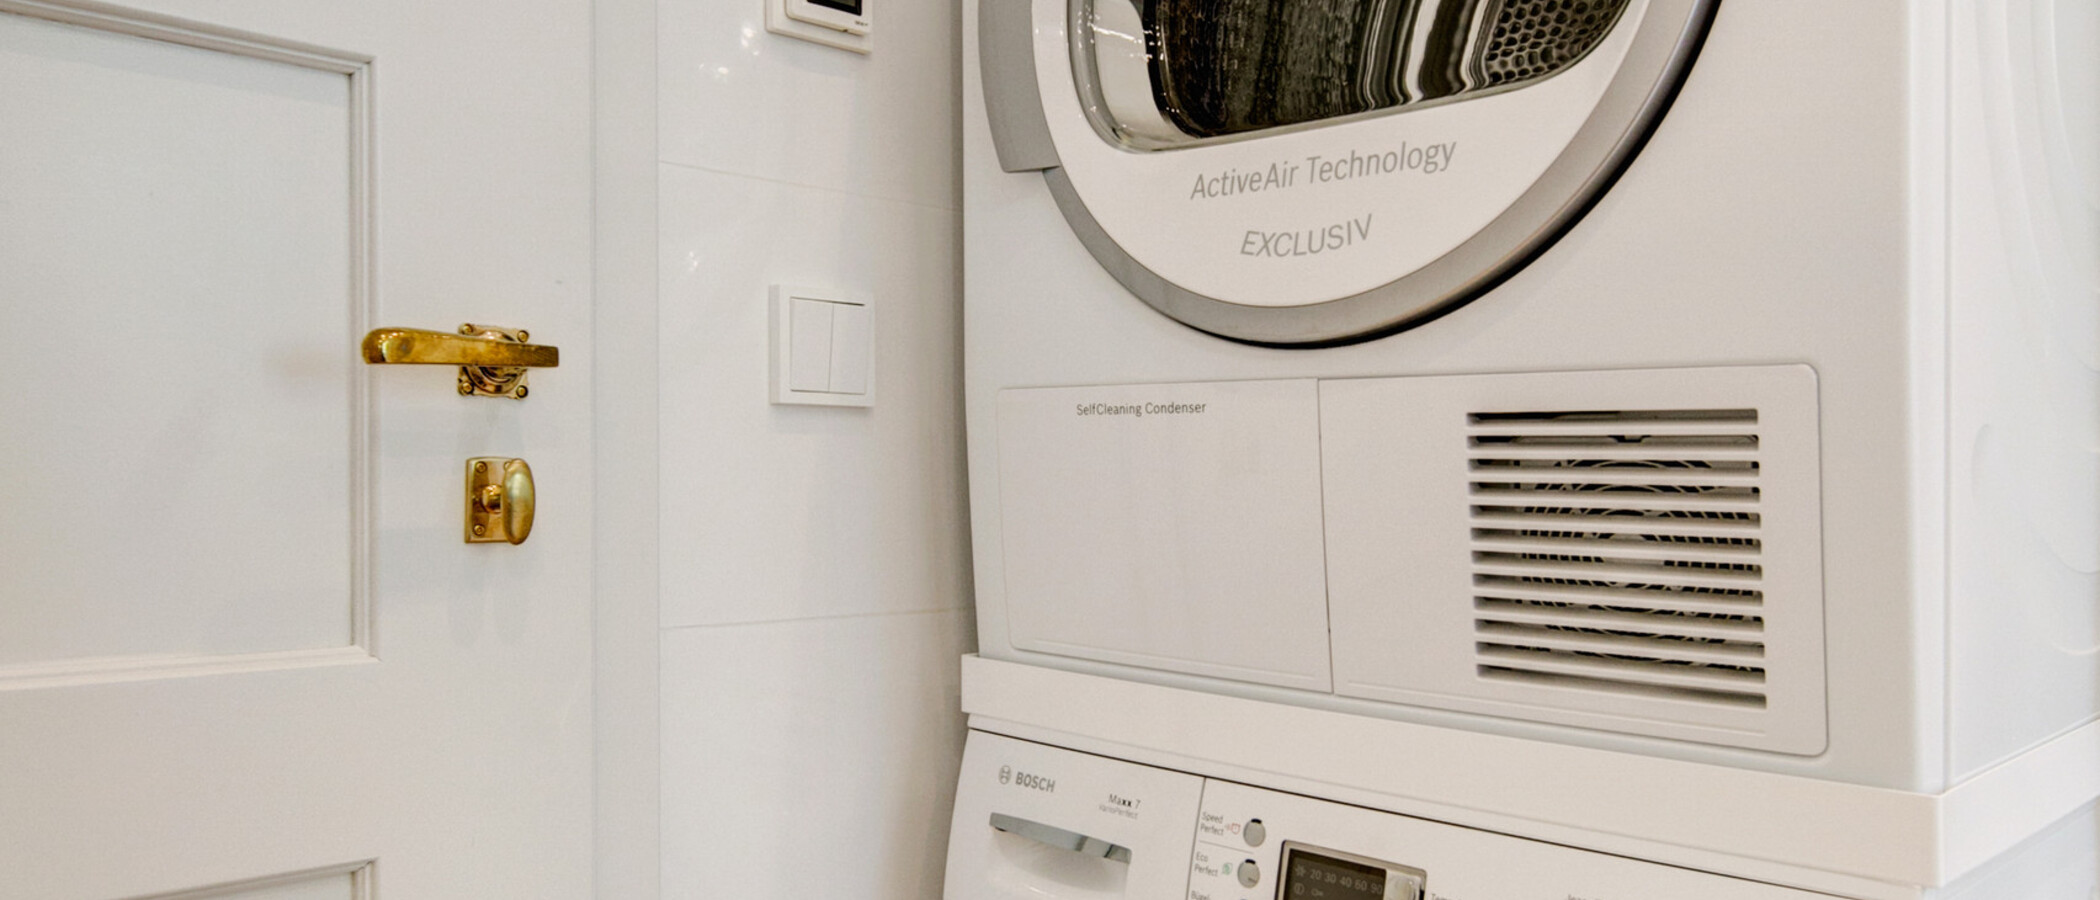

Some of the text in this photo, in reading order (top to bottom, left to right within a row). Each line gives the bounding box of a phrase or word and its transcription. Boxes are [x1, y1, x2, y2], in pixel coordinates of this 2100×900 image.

[1190, 140, 1457, 201] ActiveAir Technology
[1240, 213, 1373, 258] EXCLUSIV
[1076, 401, 1207, 418] SelfCleaning Condenser
[1015, 771, 1056, 793] BOSCH
[1108, 793, 1142, 809] Maxx 7
[1201, 811, 1224, 824] Speed
[1200, 822, 1224, 837] Perfect
[1195, 851, 1209, 863] Eco
[1194, 863, 1218, 877] Perfect
[1309, 868, 1384, 895] 20 30 40 60 90
